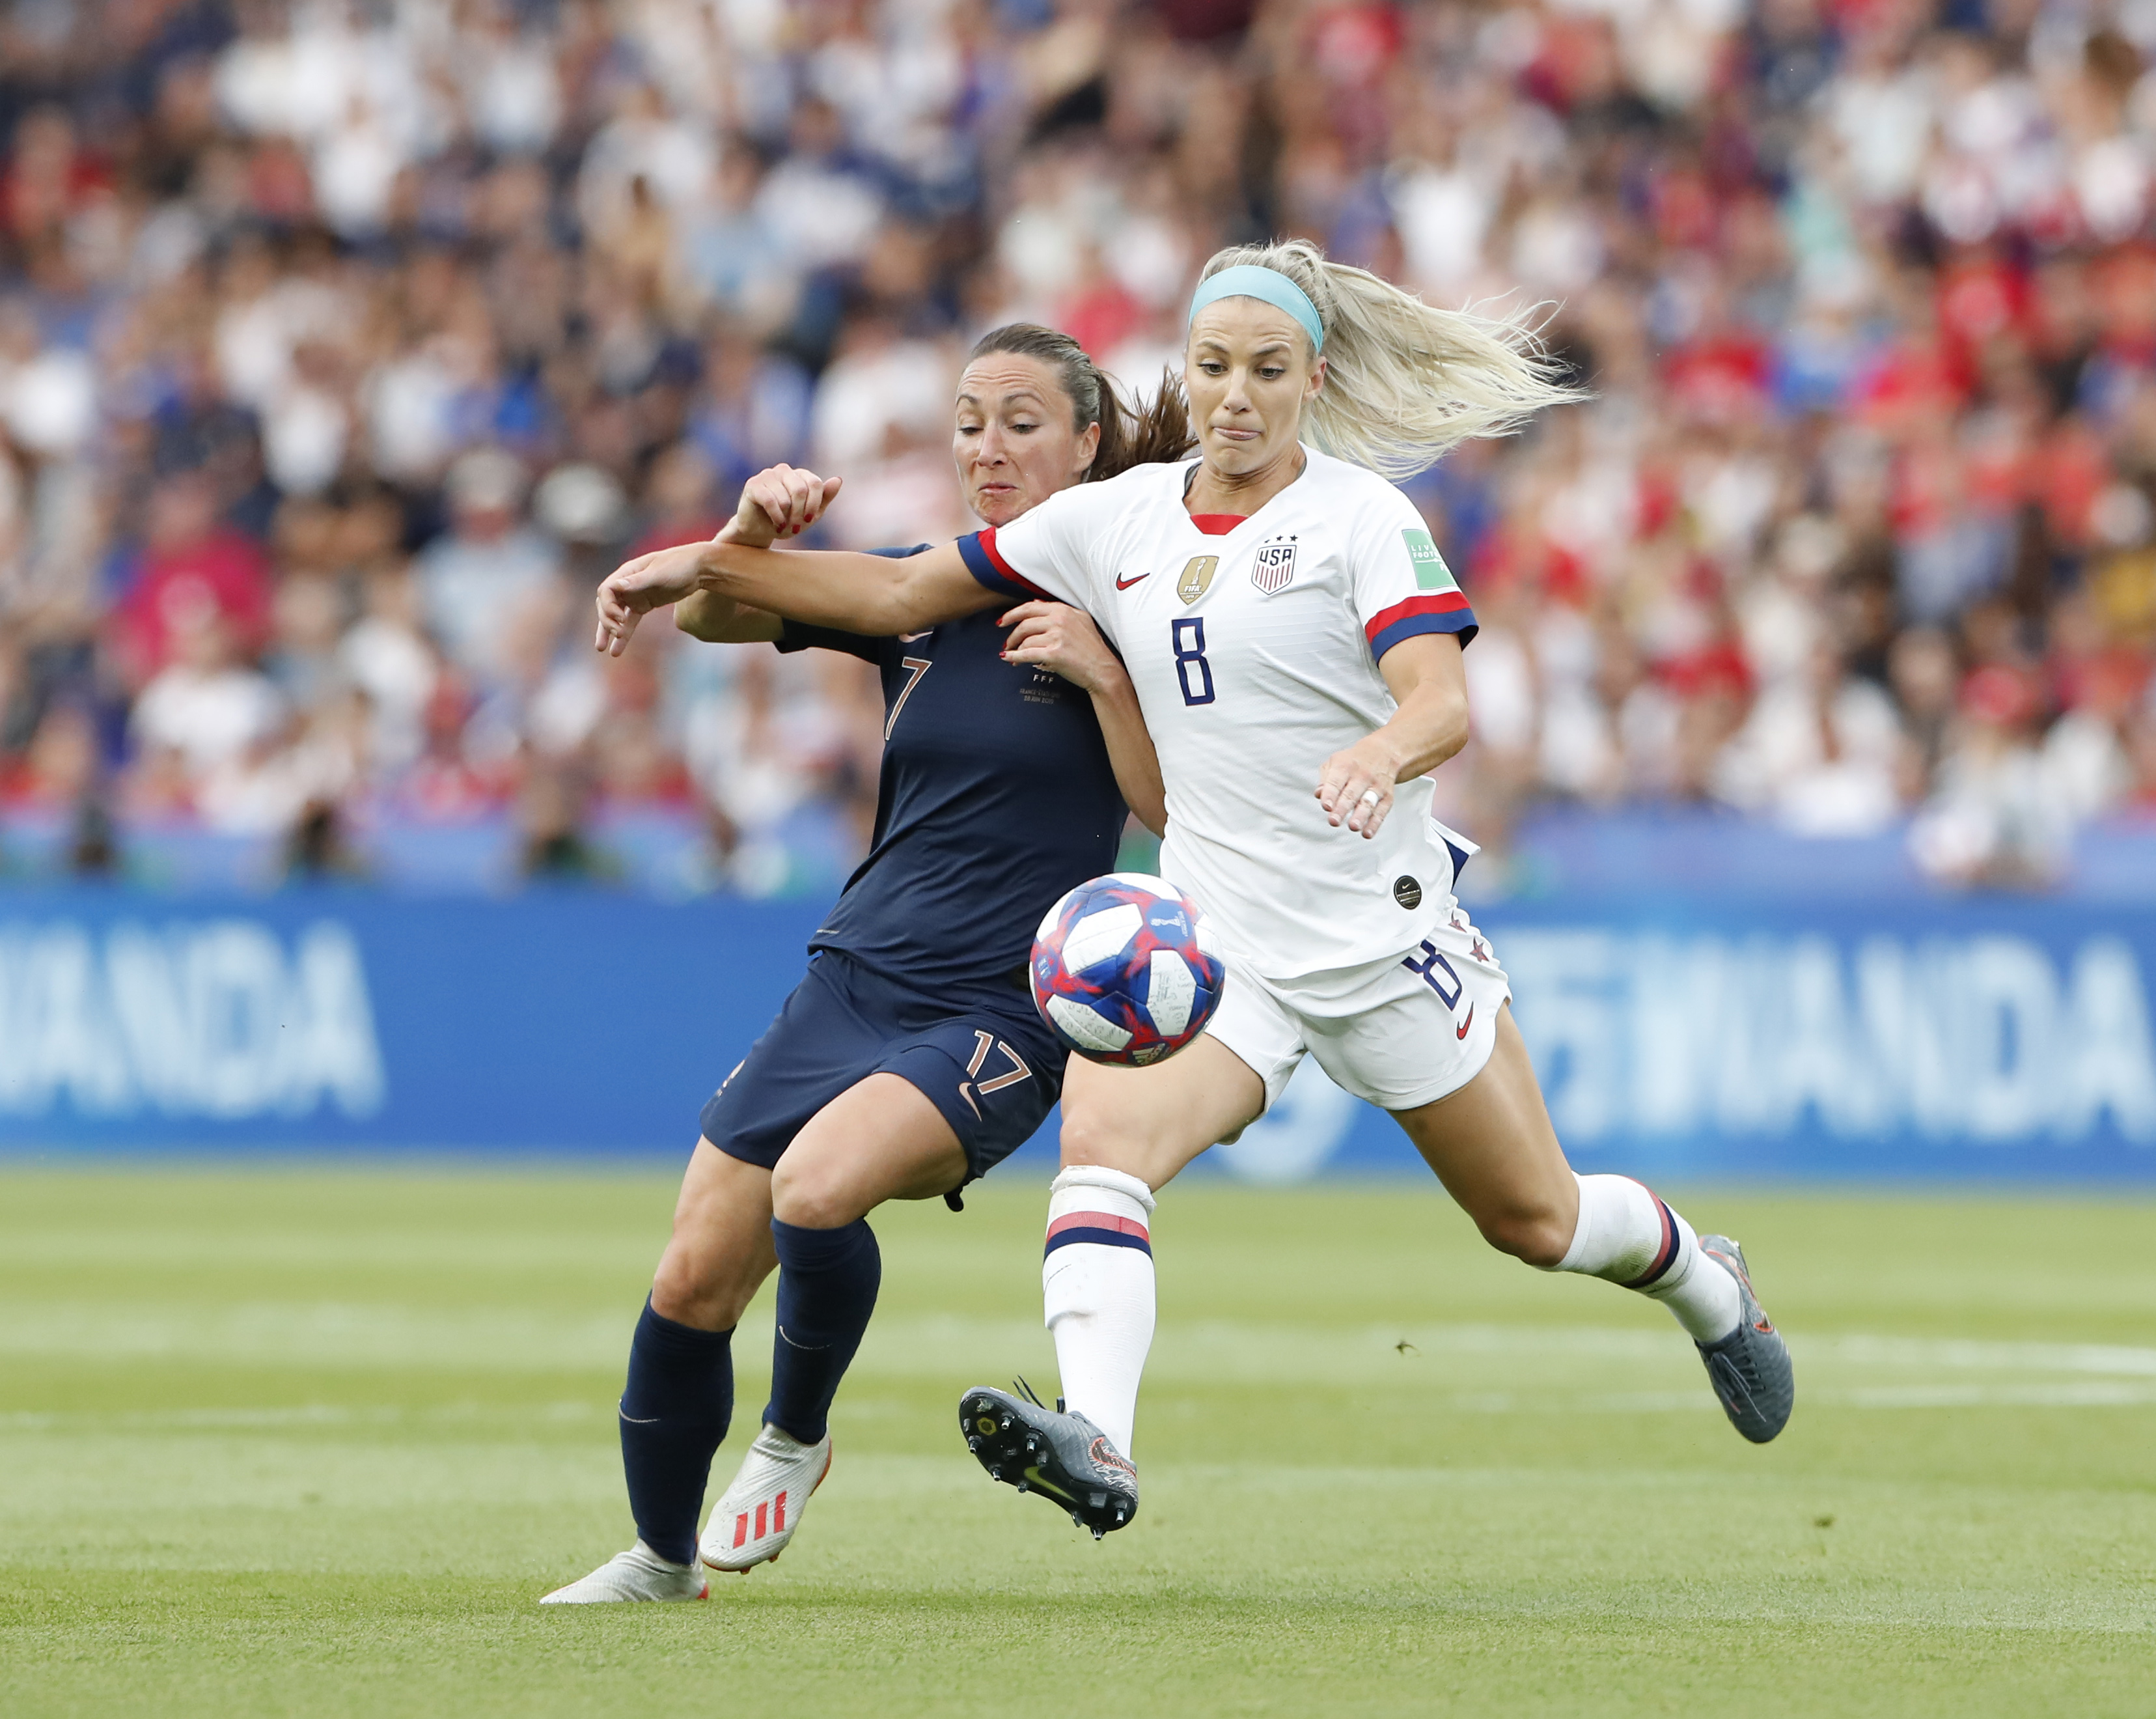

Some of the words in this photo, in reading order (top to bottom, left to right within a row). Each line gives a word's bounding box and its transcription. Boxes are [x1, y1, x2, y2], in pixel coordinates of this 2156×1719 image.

[1258, 548, 1293, 566] USA
[1171, 617, 1215, 706] 8
[1401, 938, 1463, 1013] 8
[967, 1029, 1033, 1095] 17
